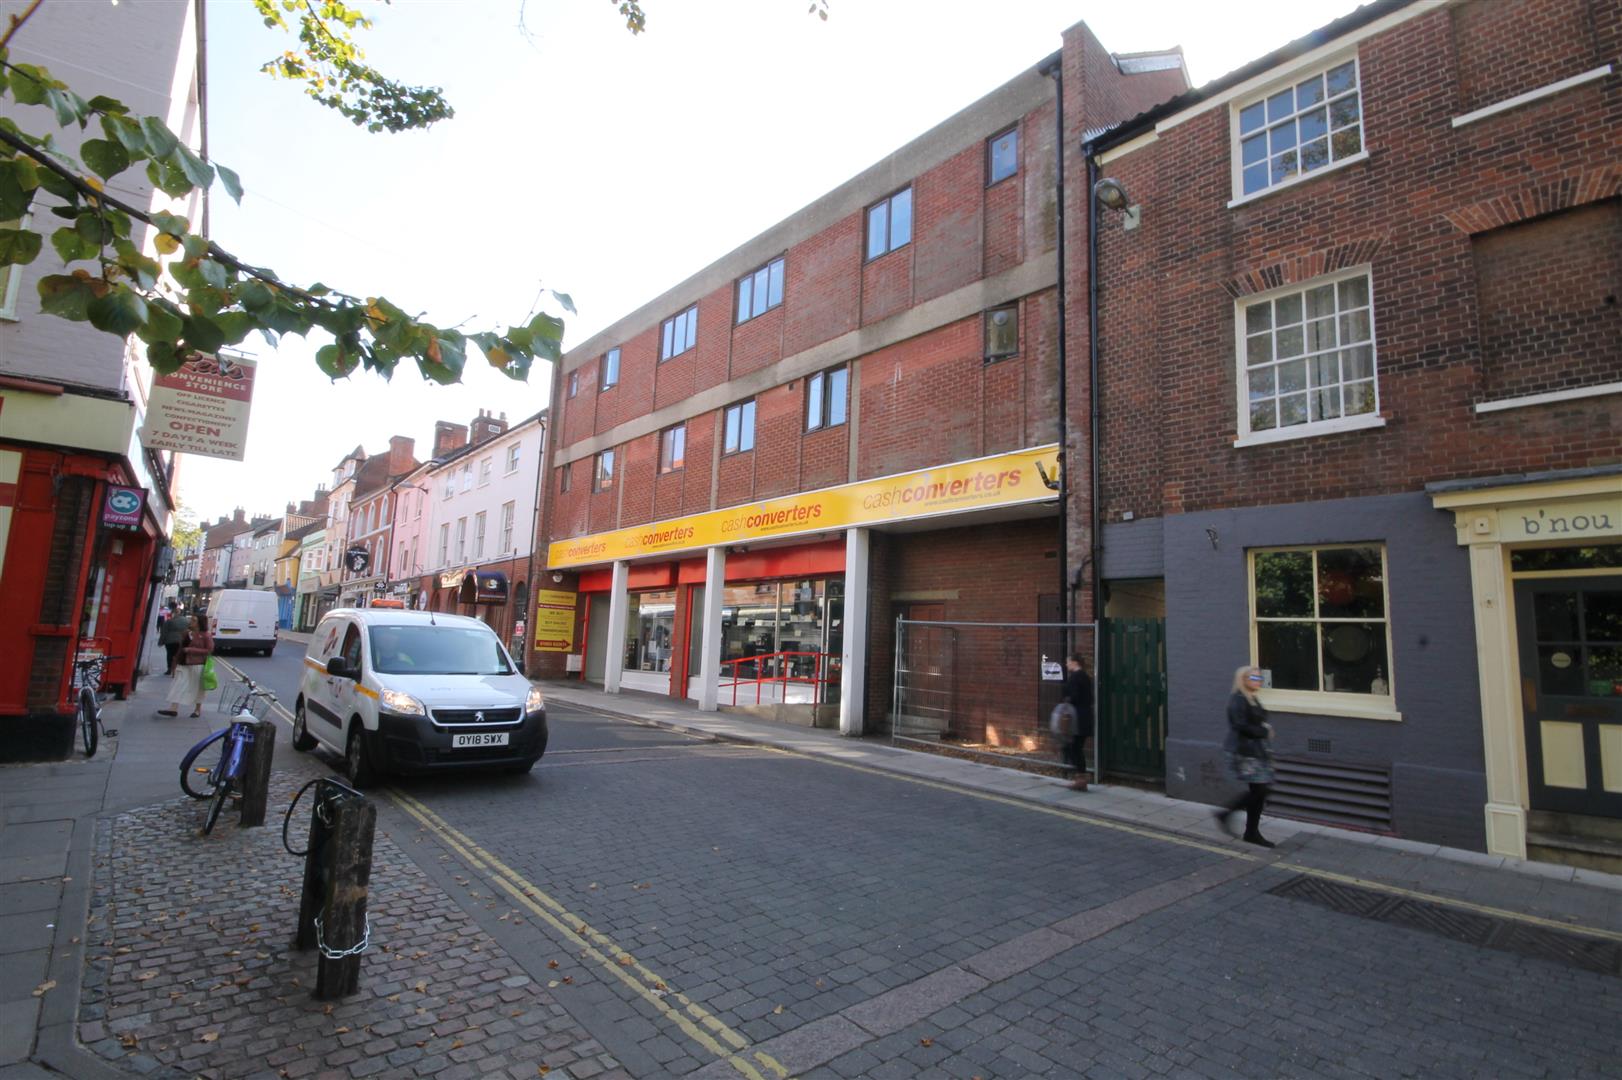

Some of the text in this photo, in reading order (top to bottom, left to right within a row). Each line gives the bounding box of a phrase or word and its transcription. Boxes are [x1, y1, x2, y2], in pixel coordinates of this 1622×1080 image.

[167, 372, 246, 391] ONVENIENCE
[185, 380, 224, 393] STORE
[169, 421, 221, 437] OPEN
[150, 439, 238, 457] EARLY TILL LATE
[162, 431, 193, 442] DAYS
[208, 439, 239, 449] WEEK
[1521, 509, 1614, 535] b'nou
[483, 734, 503, 744] SWX
